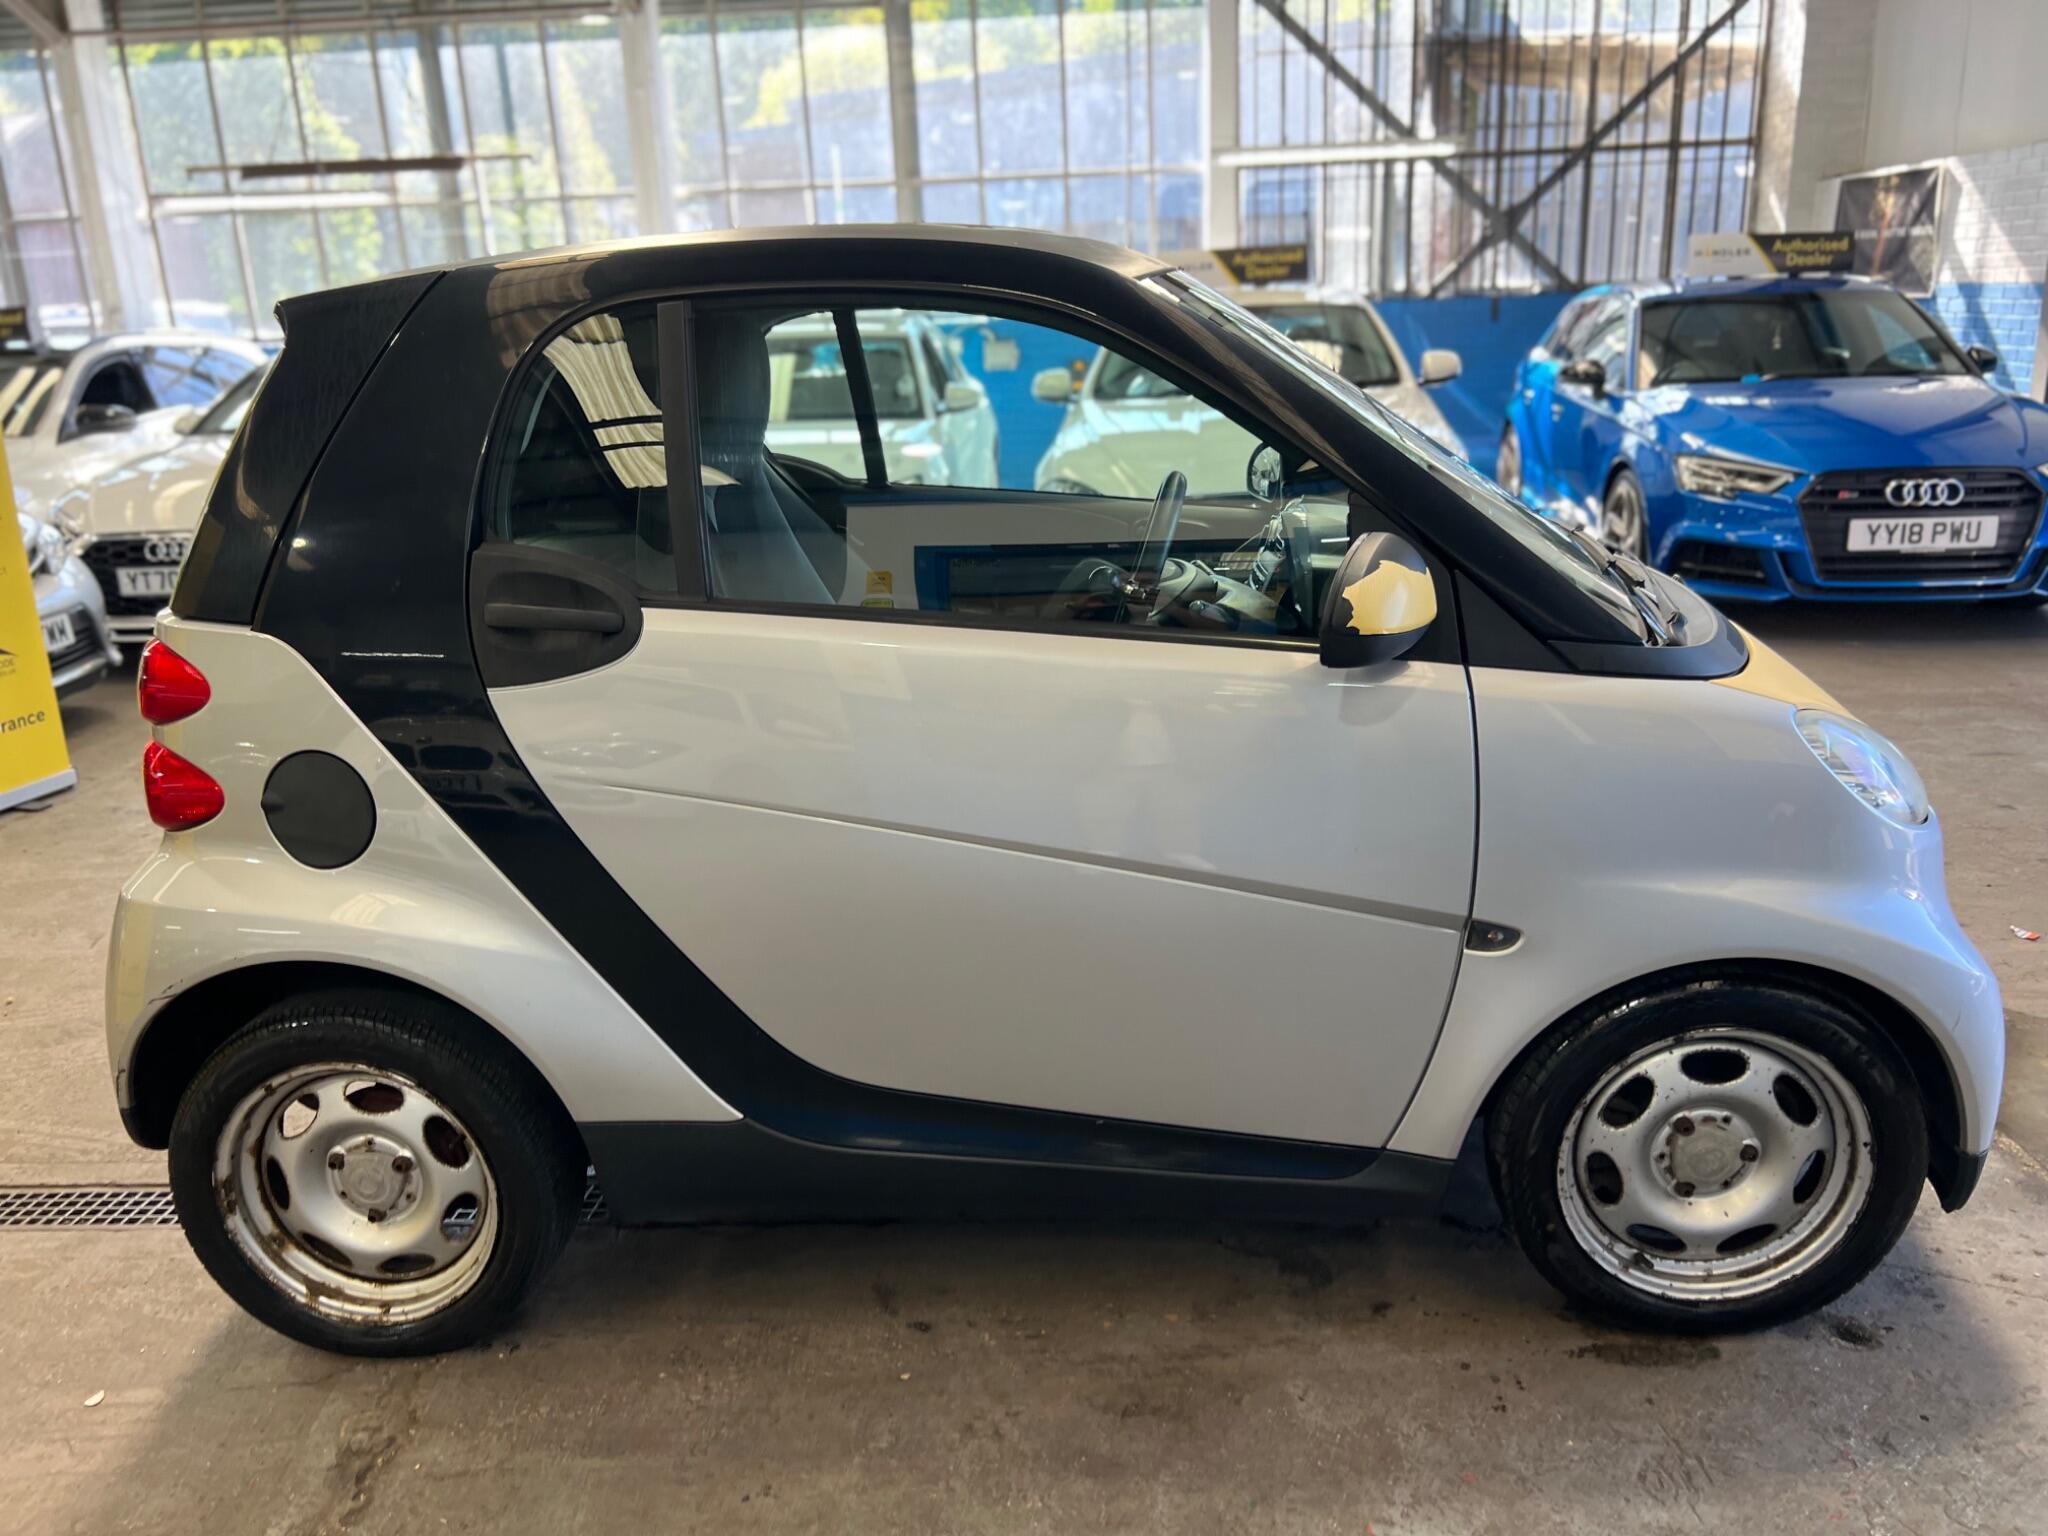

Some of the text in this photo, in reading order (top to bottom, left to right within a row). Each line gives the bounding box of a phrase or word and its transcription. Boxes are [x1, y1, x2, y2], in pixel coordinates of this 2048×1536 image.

[1773, 237, 1849, 253] Authorised
[1785, 252, 1834, 267] Dealer
[1867, 520, 1982, 545] YY18 PWU
